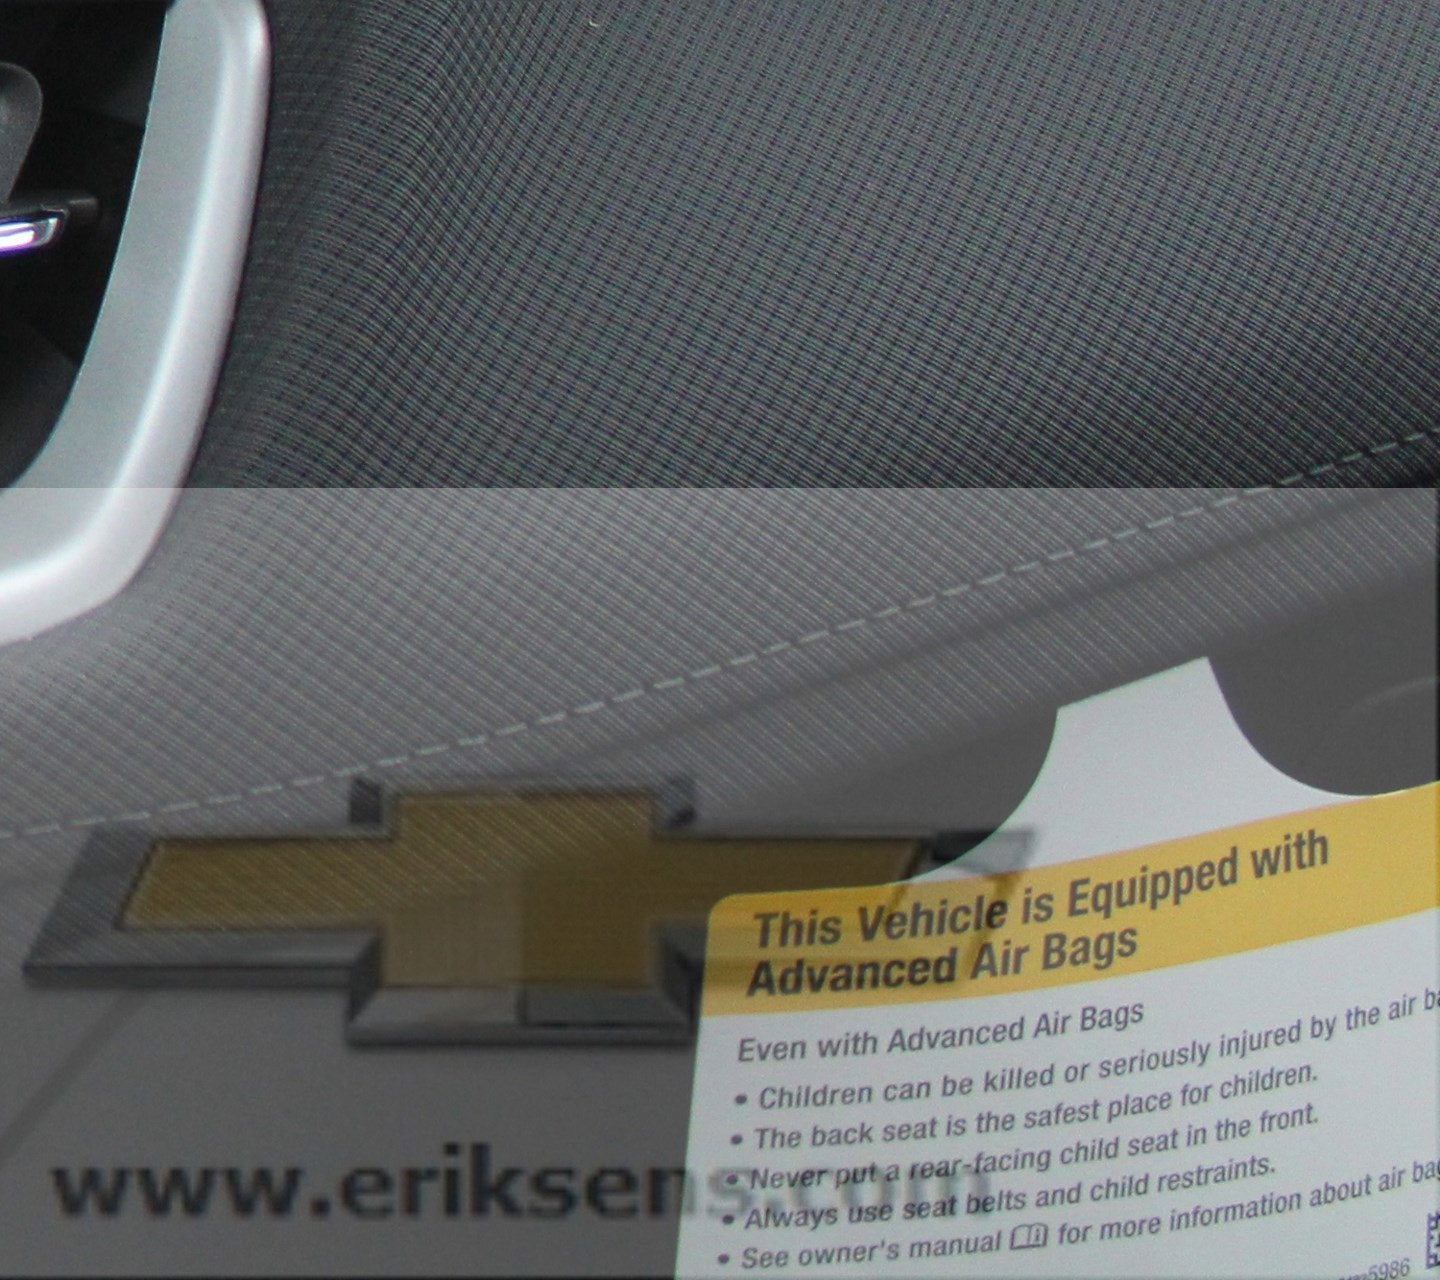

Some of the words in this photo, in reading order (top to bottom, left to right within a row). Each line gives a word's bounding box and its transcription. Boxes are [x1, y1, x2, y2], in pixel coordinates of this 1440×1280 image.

[754, 909, 842, 949] This
[858, 895, 1008, 941] Vehicle
[1021, 888, 1054, 924] is
[1067, 846, 1237, 919] Equipped
[1251, 829, 1328, 879] with
[746, 947, 958, 997] Advanced
[970, 940, 1029, 980] Air
[1042, 928, 1138, 970] Bags
[737, 1038, 806, 1062] Even
[818, 1031, 878, 1057] with
[886, 1016, 1025, 1052] Advanced
[1033, 1011, 1072, 1038] Air
[1080, 1003, 1144, 1032] Bags
[759, 1084, 873, 1110] Children
[883, 1080, 931, 1101] can
[941, 1075, 973, 1097] be
[983, 1063, 1055, 1093] killed
[1064, 1063, 1090, 1082] or
[1099, 1041, 1211, 1079] seriously
[1219, 1019, 1302, 1058] injured
[1310, 1016, 1337, 1041] by
[1345, 1005, 1380, 1031] the
[1388, 992, 1417, 1020] air
[750, 1168, 828, 1189] Never
[835, 1162, 877, 1188] put
[884, 1165, 900, 1182] a
[908, 1148, 1051, 1181] rear-facing
[1060, 1137, 1120, 1165] child
[1127, 1129, 1179, 1157] seat
[1187, 1124, 1207, 1146] in
[1215, 1118, 1251, 1142] the
[1260, 1102, 1319, 1134] front.
[754, 1128, 802, 1149] The
[811, 1122, 873, 1146] back
[883, 1116, 937, 1142] seat
[946, 1115, 967, 1137] is
[976, 1111, 1015, 1133] the
[1024, 1099, 1100, 1129] safest
[1108, 1092, 1172, 1122] place
[1181, 1083, 1212, 1106] for
[1220, 1063, 1318, 1099] children.
[741, 1247, 789, 1269] See
[798, 1241, 899, 1267] owner's
[908, 1231, 1002, 1259] manual
[1058, 1223, 1093, 1244] for
[1099, 1215, 1161, 1240] more
[1169, 1189, 1302, 1231] information
[1310, 1173, 1372, 1207] about
[1378, 1166, 1406, 1192] air
[744, 1207, 838, 1231] Always
[848, 1204, 893, 1223] use
[903, 1194, 957, 1220] seat
[966, 1189, 1026, 1215] belts
[1035, 1181, 1082, 1208] and
[1090, 1173, 1150, 1202] child
[1157, 1155, 1276, 1193] restraints.
